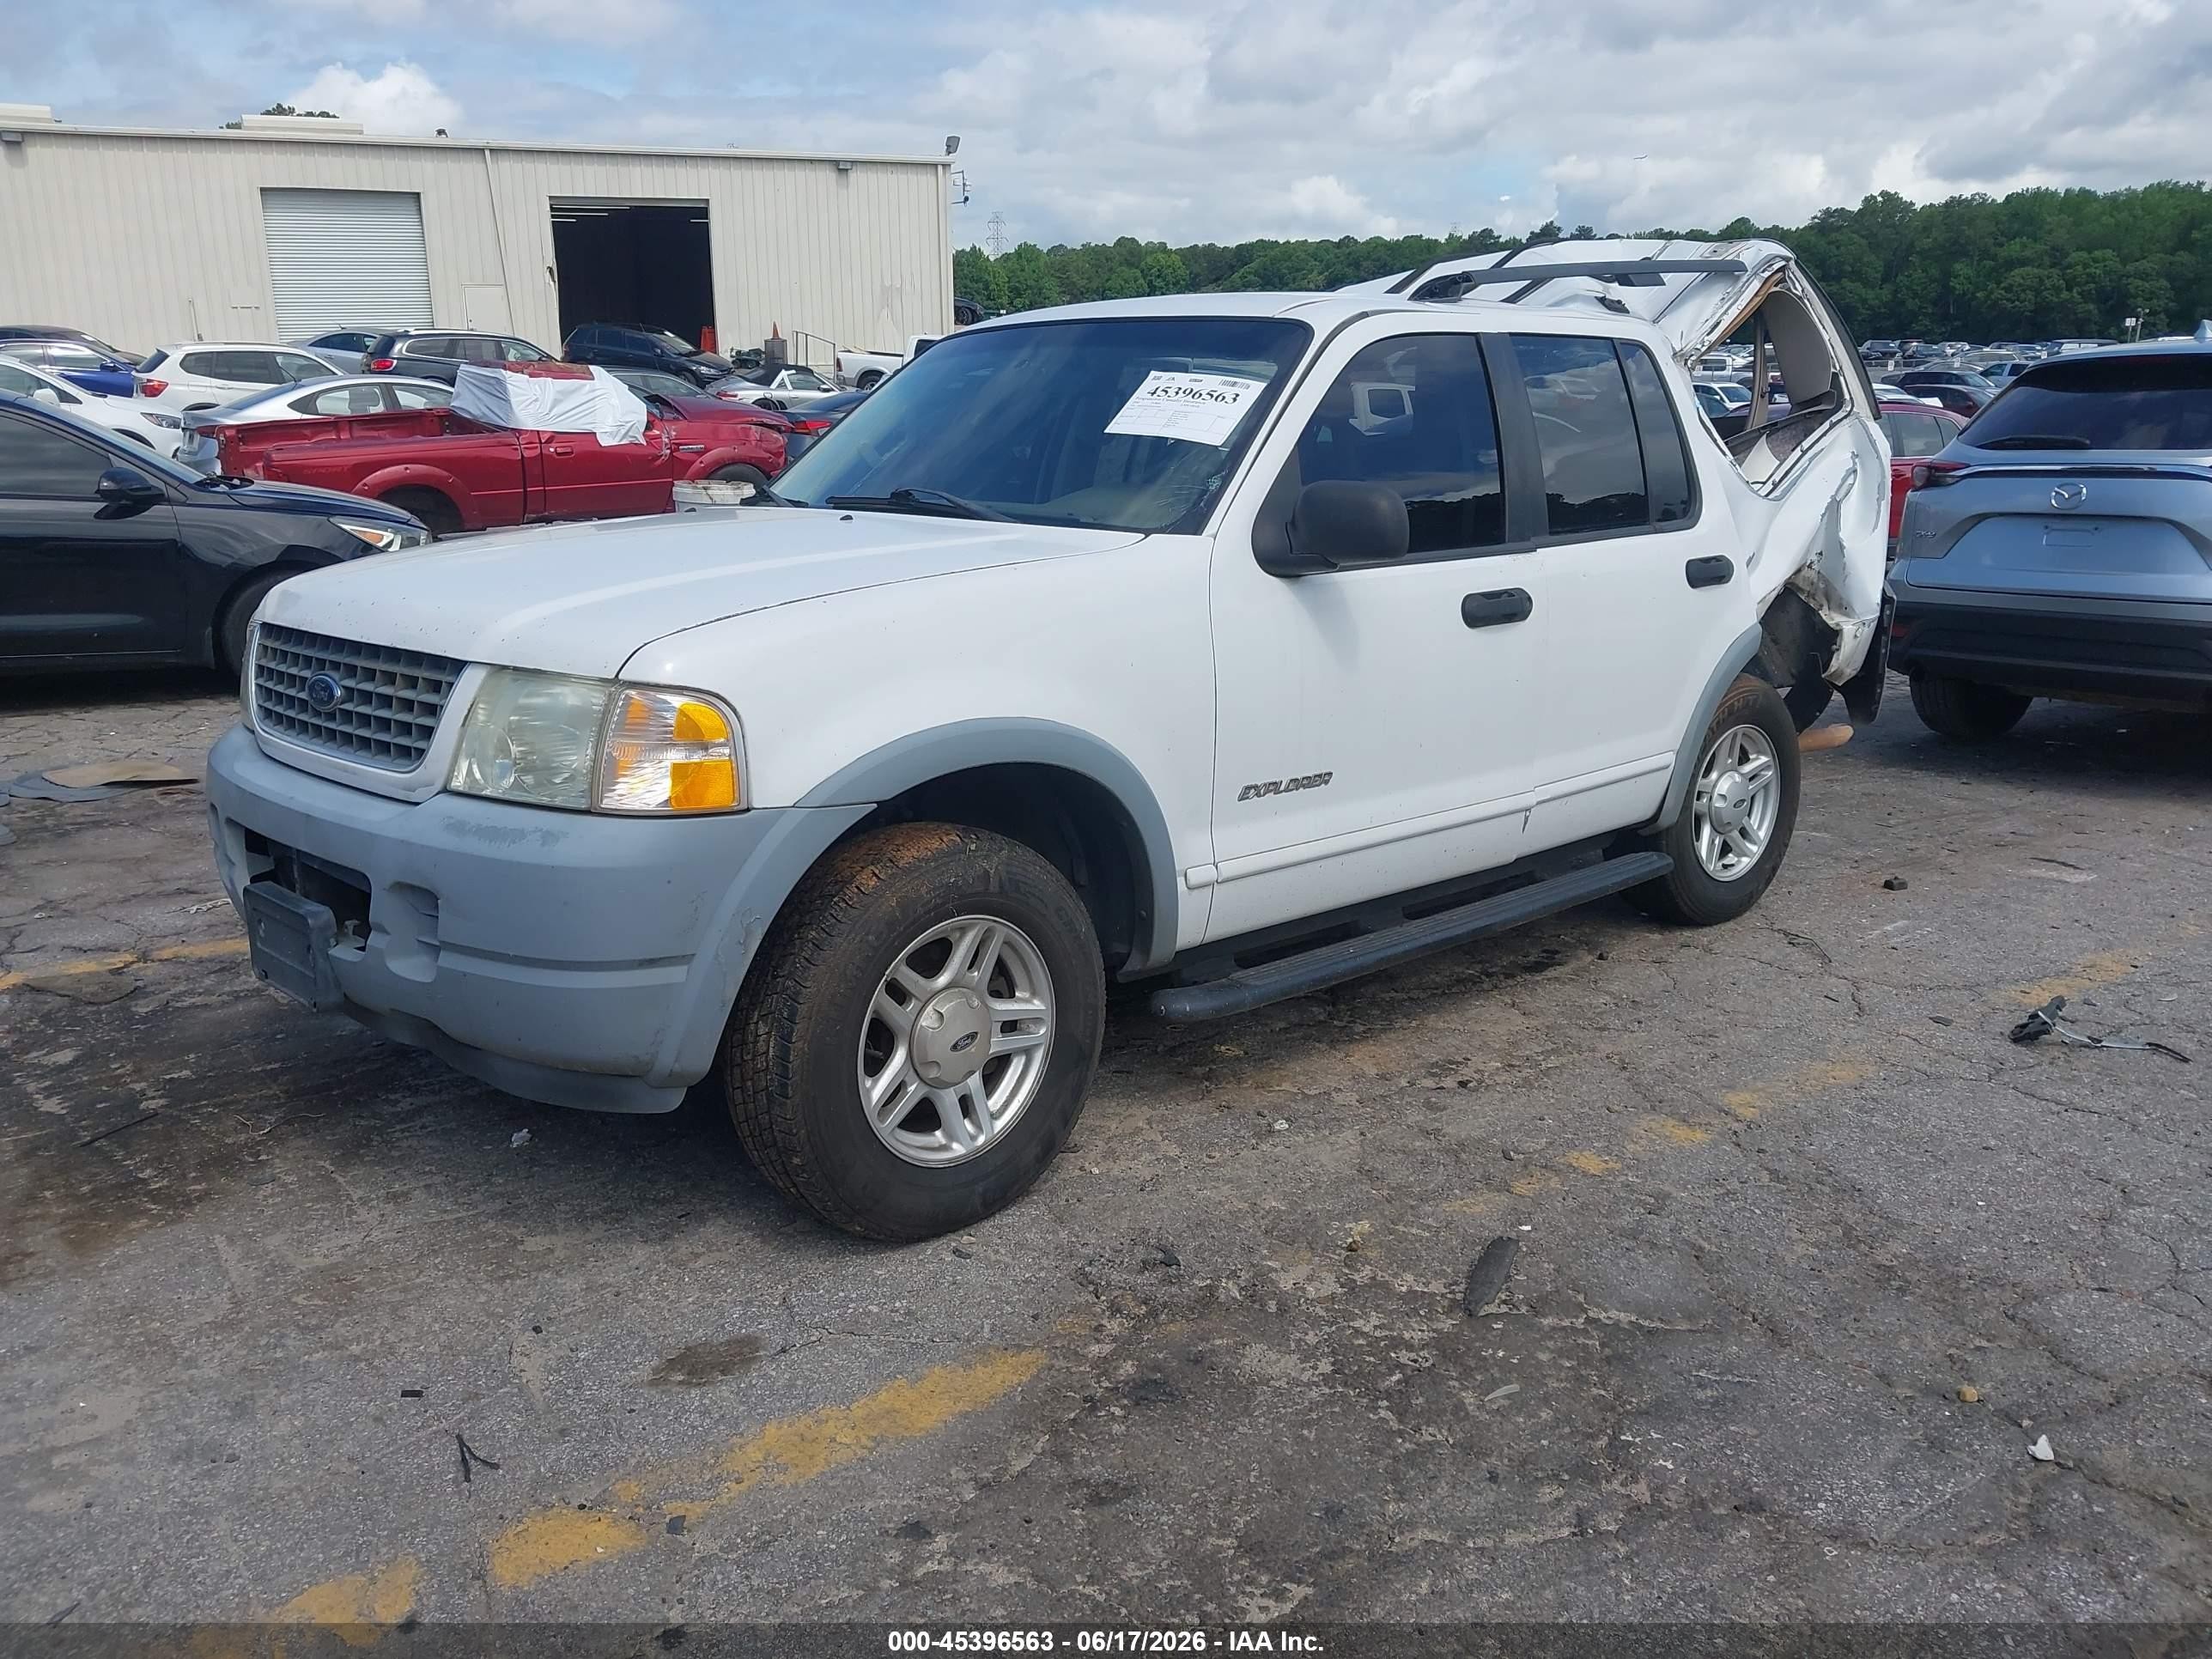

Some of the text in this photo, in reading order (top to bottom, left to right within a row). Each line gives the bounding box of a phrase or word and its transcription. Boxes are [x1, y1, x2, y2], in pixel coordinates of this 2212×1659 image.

[1146, 386, 1241, 404] 45396563
[1237, 771, 1334, 802] EXPLORER
[951, 1033, 975, 1050] Ford
